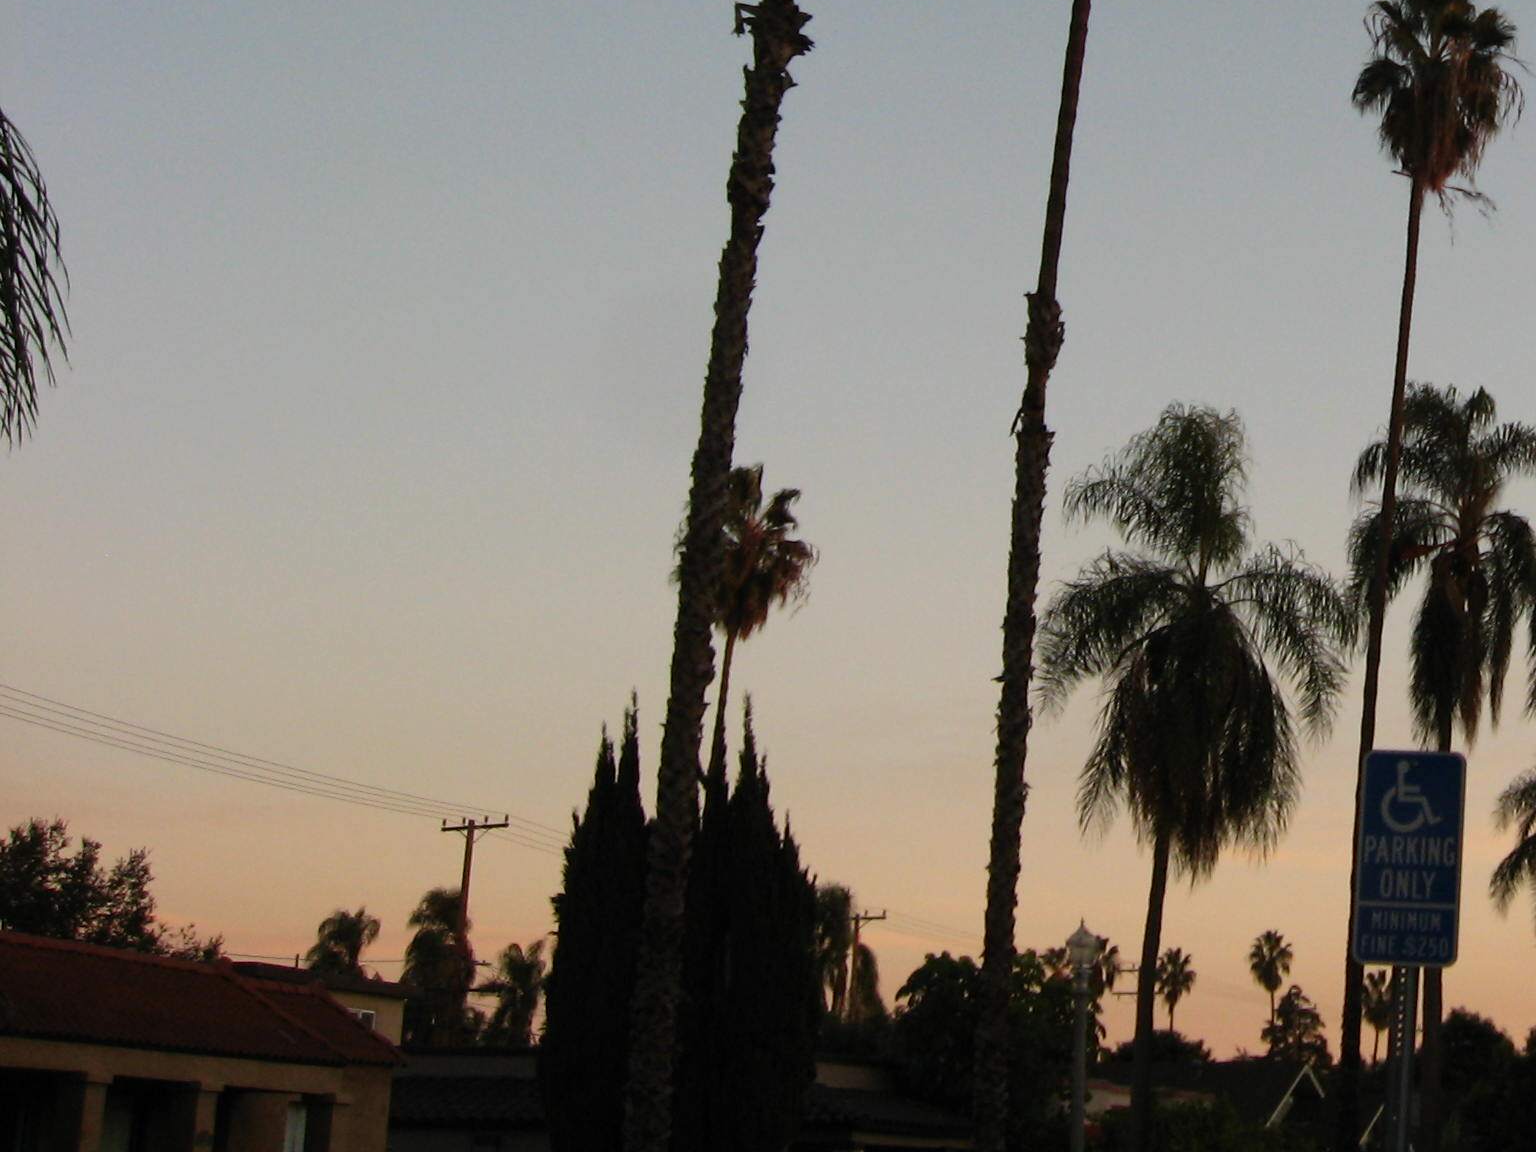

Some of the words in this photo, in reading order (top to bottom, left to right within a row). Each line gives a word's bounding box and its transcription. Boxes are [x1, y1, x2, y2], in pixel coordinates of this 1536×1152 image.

[1364, 835, 1456, 865] PARKING
[1380, 869, 1435, 899] ONLY
[1371, 911, 1442, 931] MINIMUM
[1361, 934, 1397, 955] FINE
